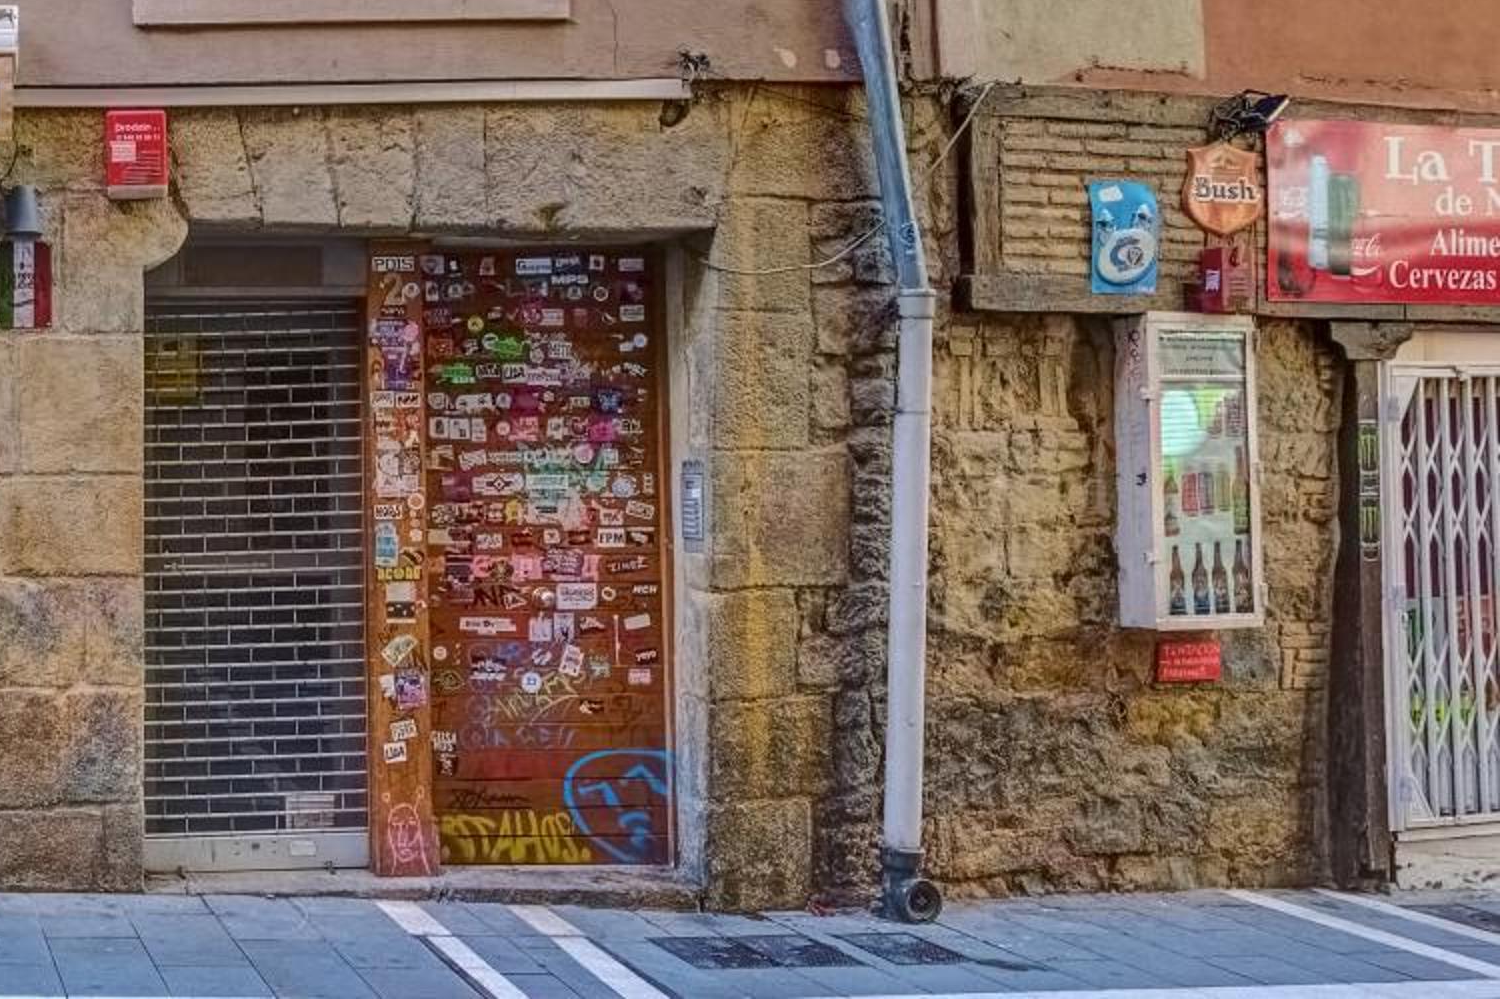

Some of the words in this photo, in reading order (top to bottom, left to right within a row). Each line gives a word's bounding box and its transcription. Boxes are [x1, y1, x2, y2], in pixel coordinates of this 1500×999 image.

[1384, 136, 1449, 185] La
[1195, 175, 1257, 201] Bush
[1435, 185, 1473, 216] de
[1430, 228, 1500, 257] Alime
[1389, 259, 1497, 290] Cervezas
